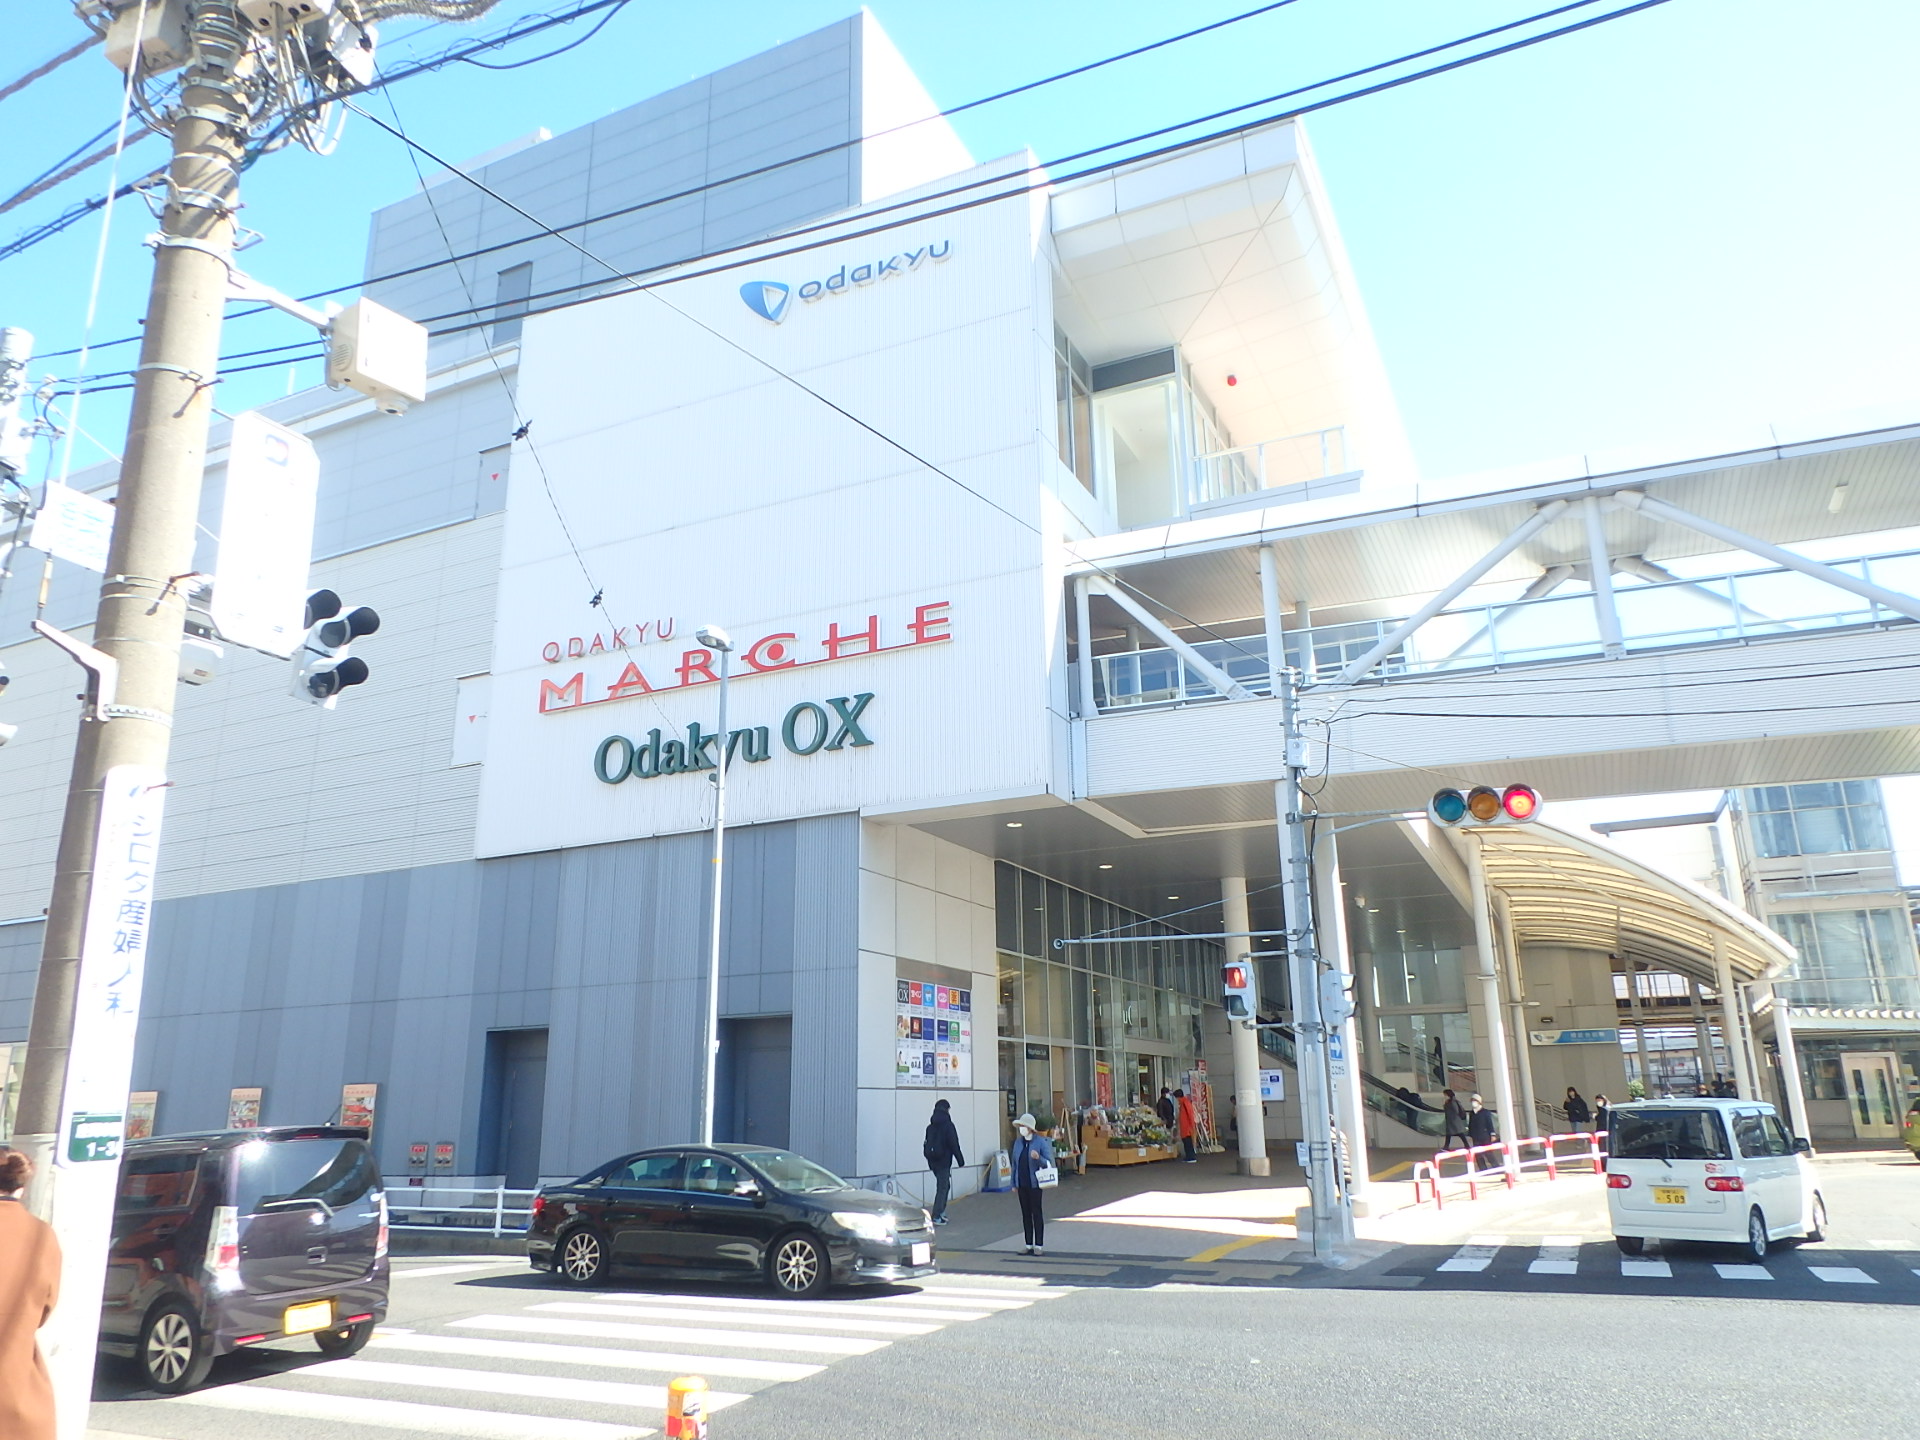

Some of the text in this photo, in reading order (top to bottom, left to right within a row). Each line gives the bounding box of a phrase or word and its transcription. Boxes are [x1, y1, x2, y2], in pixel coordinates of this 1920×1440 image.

[798, 240, 950, 301] odakyu
[539, 600, 952, 714] MARCHE
[542, 616, 676, 664] ODAKYU
[593, 692, 876, 786] Odakyu OX
